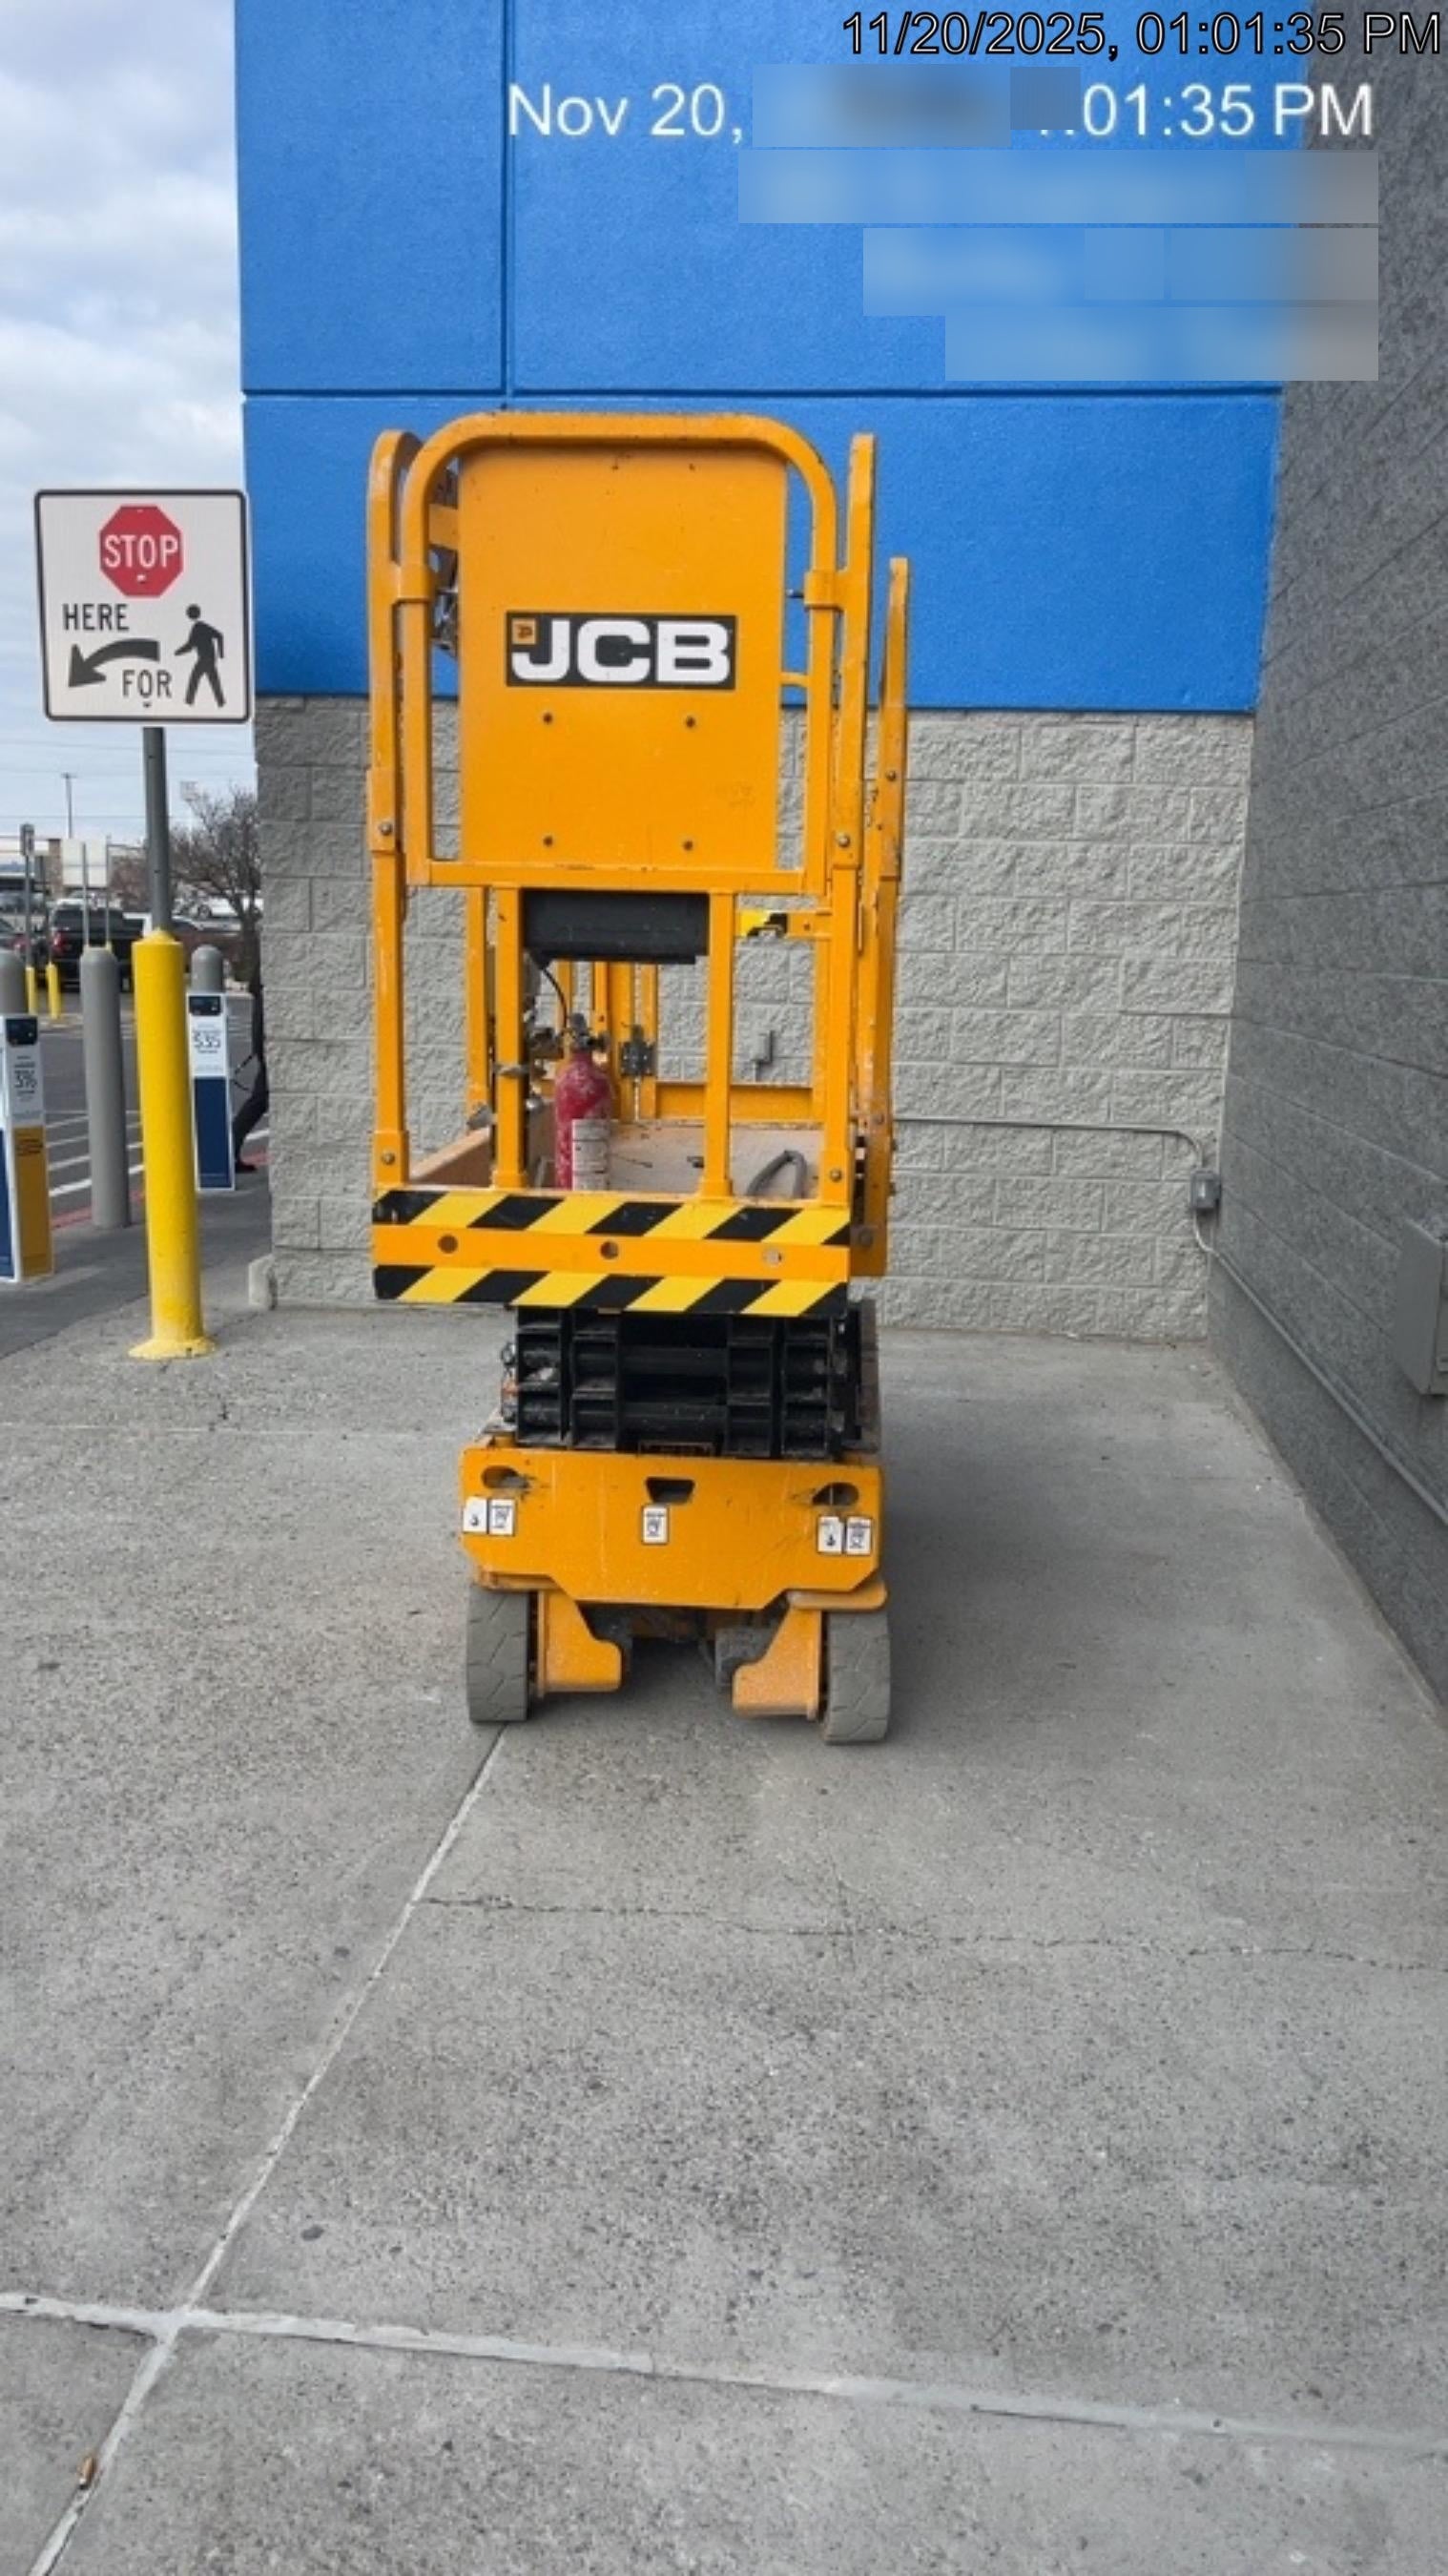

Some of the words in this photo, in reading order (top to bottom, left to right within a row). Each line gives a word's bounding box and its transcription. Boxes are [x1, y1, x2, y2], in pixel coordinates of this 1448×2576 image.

[103, 534, 178, 569] STOP
[62, 603, 130, 631] HERE
[510, 618, 731, 683] JCB
[122, 669, 173, 698] FOR
